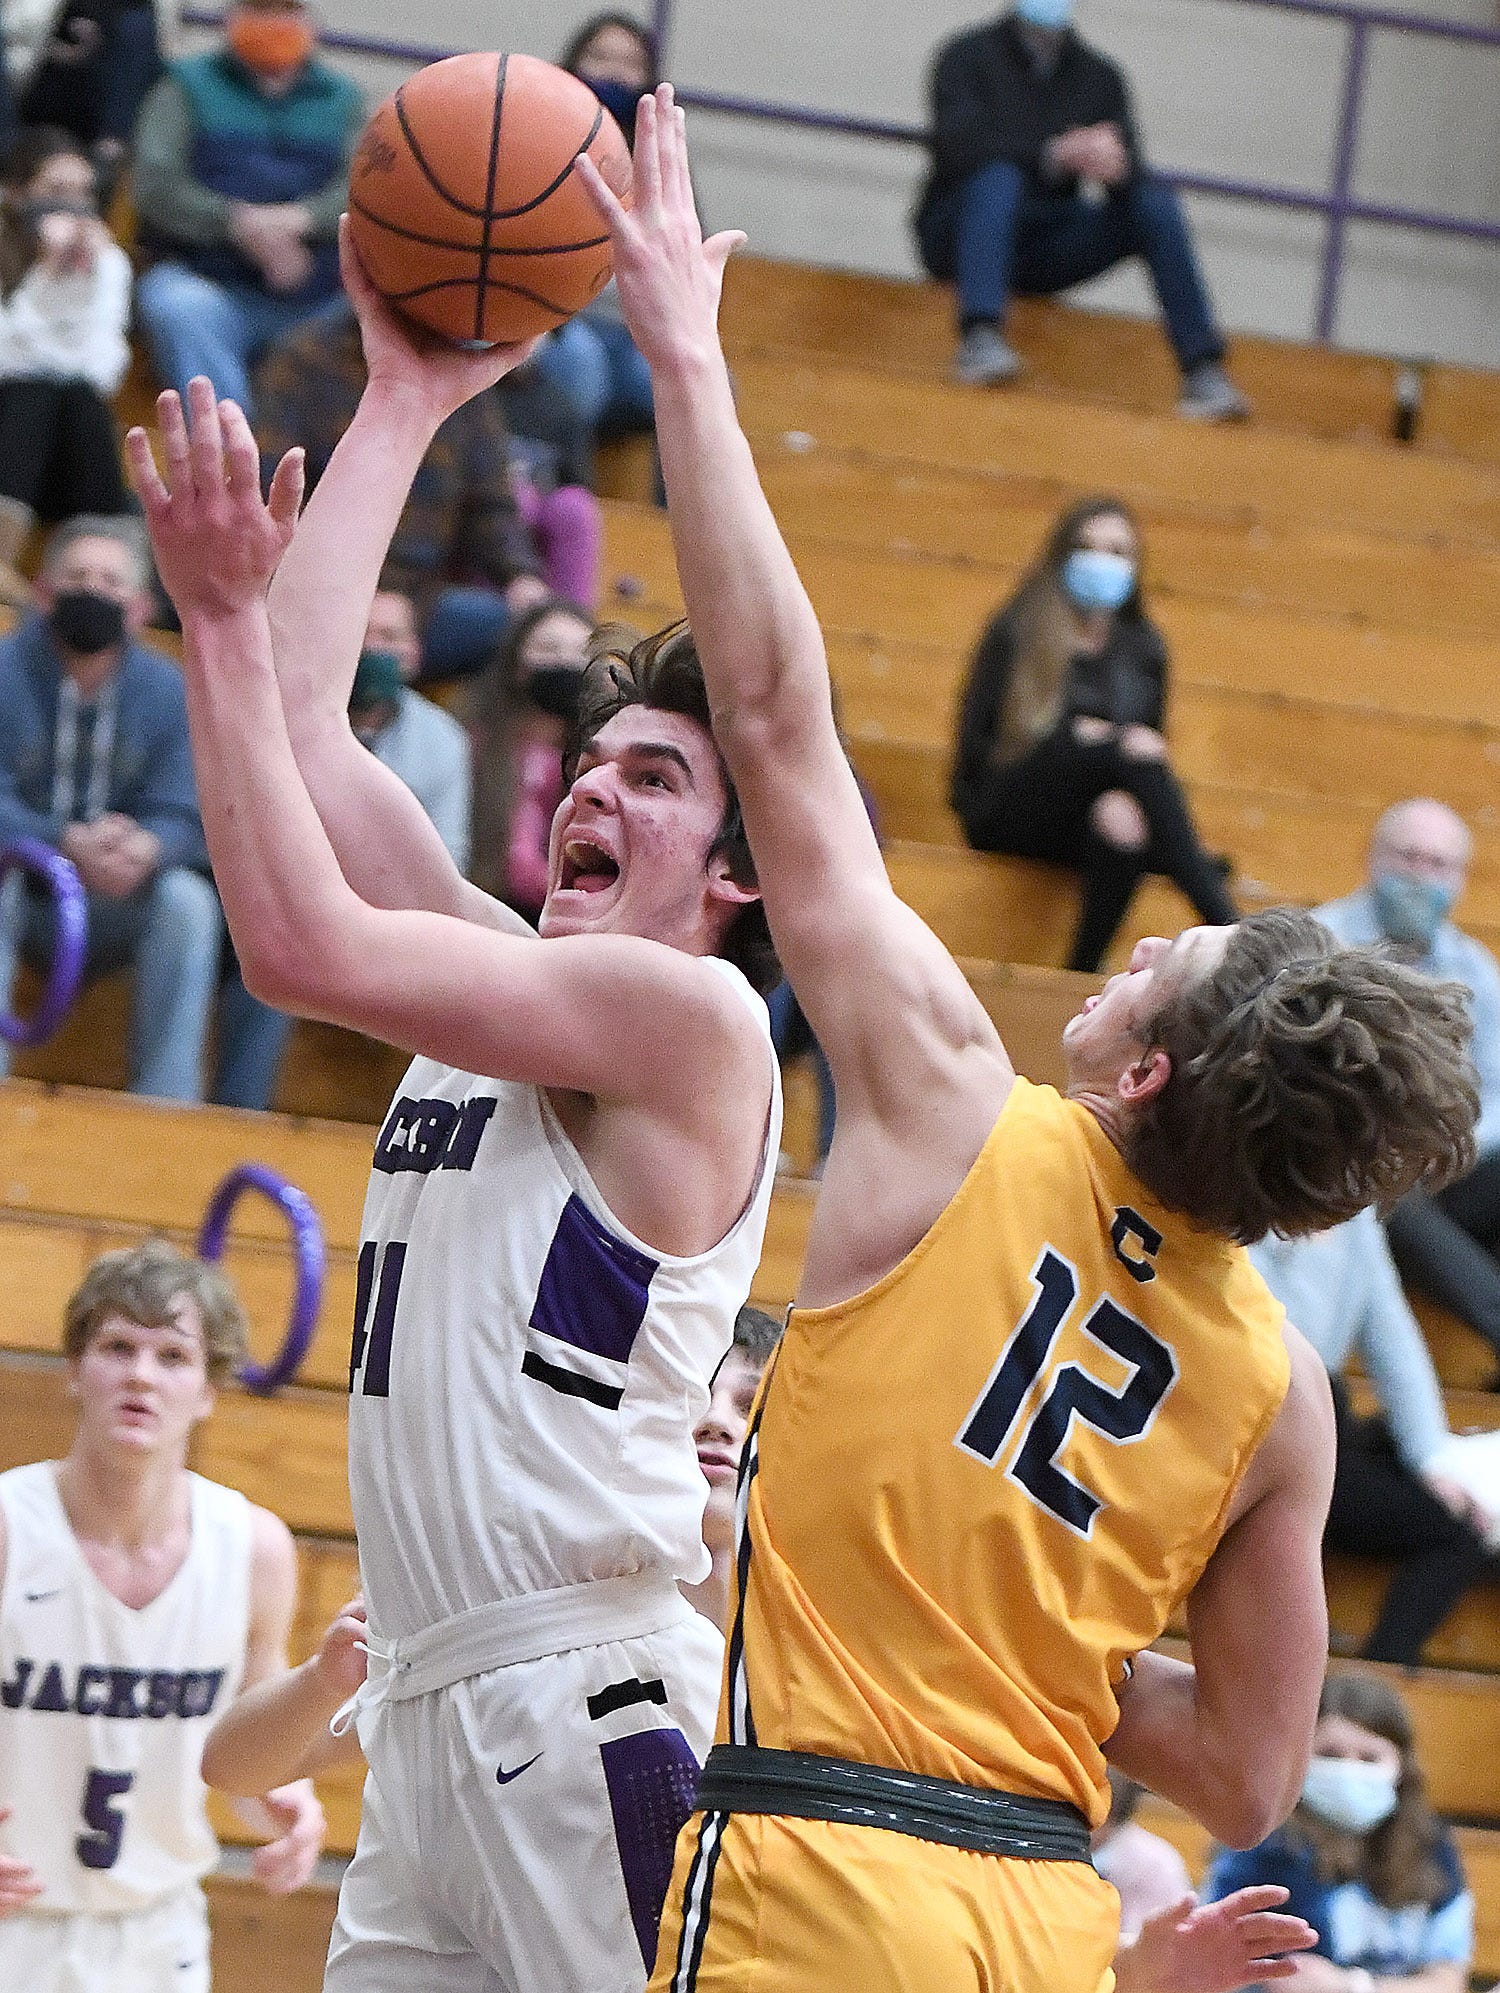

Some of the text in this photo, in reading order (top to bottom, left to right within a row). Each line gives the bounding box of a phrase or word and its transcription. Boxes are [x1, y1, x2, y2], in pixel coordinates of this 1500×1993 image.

[1110, 1205, 1164, 1284] C
[952, 1241, 1181, 1542] 12
[75, 1768, 135, 1870] 5
